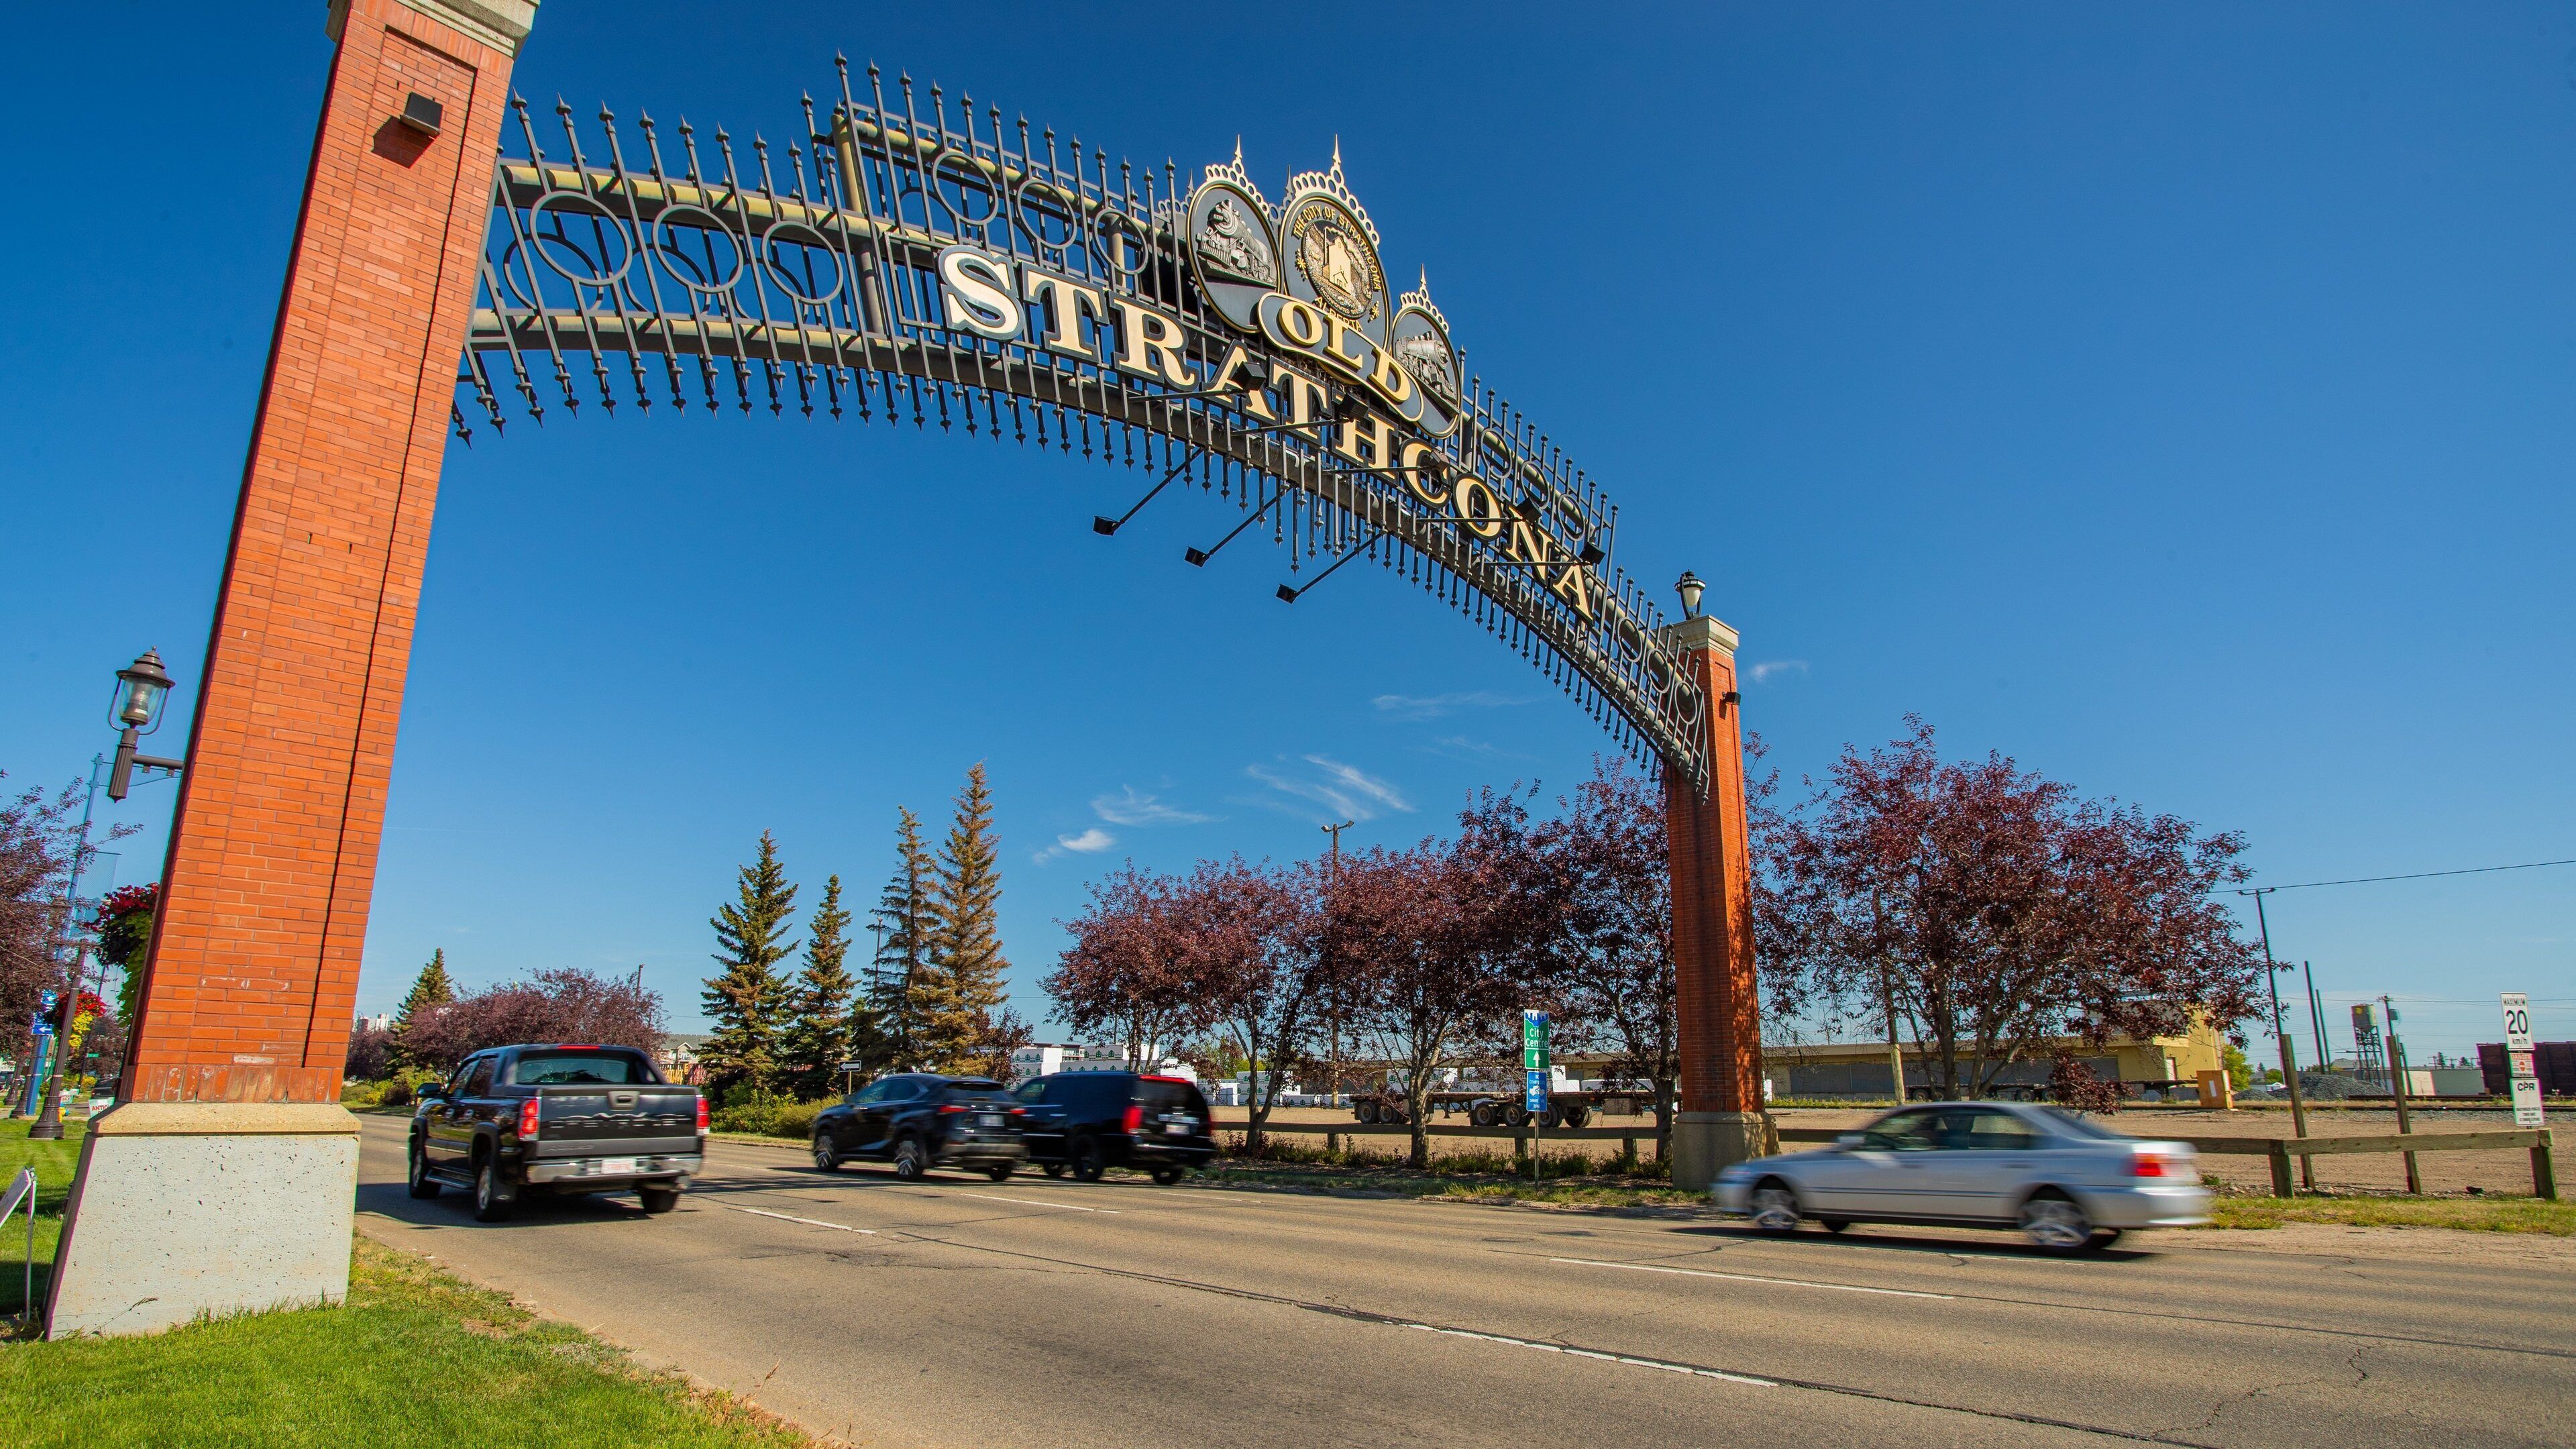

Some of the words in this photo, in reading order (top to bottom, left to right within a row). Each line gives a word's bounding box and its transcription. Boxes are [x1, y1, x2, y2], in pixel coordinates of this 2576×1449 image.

[1293, 214, 1307, 237] THE
[1303, 205, 1322, 221] CITY
[1324, 206, 1336, 219] OF
[1338, 214, 1382, 290] STRATHCONA
[1278, 301, 1411, 403] OLD
[938, 244, 1595, 627] STRATHCONA
[1529, 1028, 1544, 1040] City
[2506, 1010, 2528, 1034] 20
[1525, 1038, 1548, 1047] Centre
[2518, 1083, 2534, 1091] CPR
